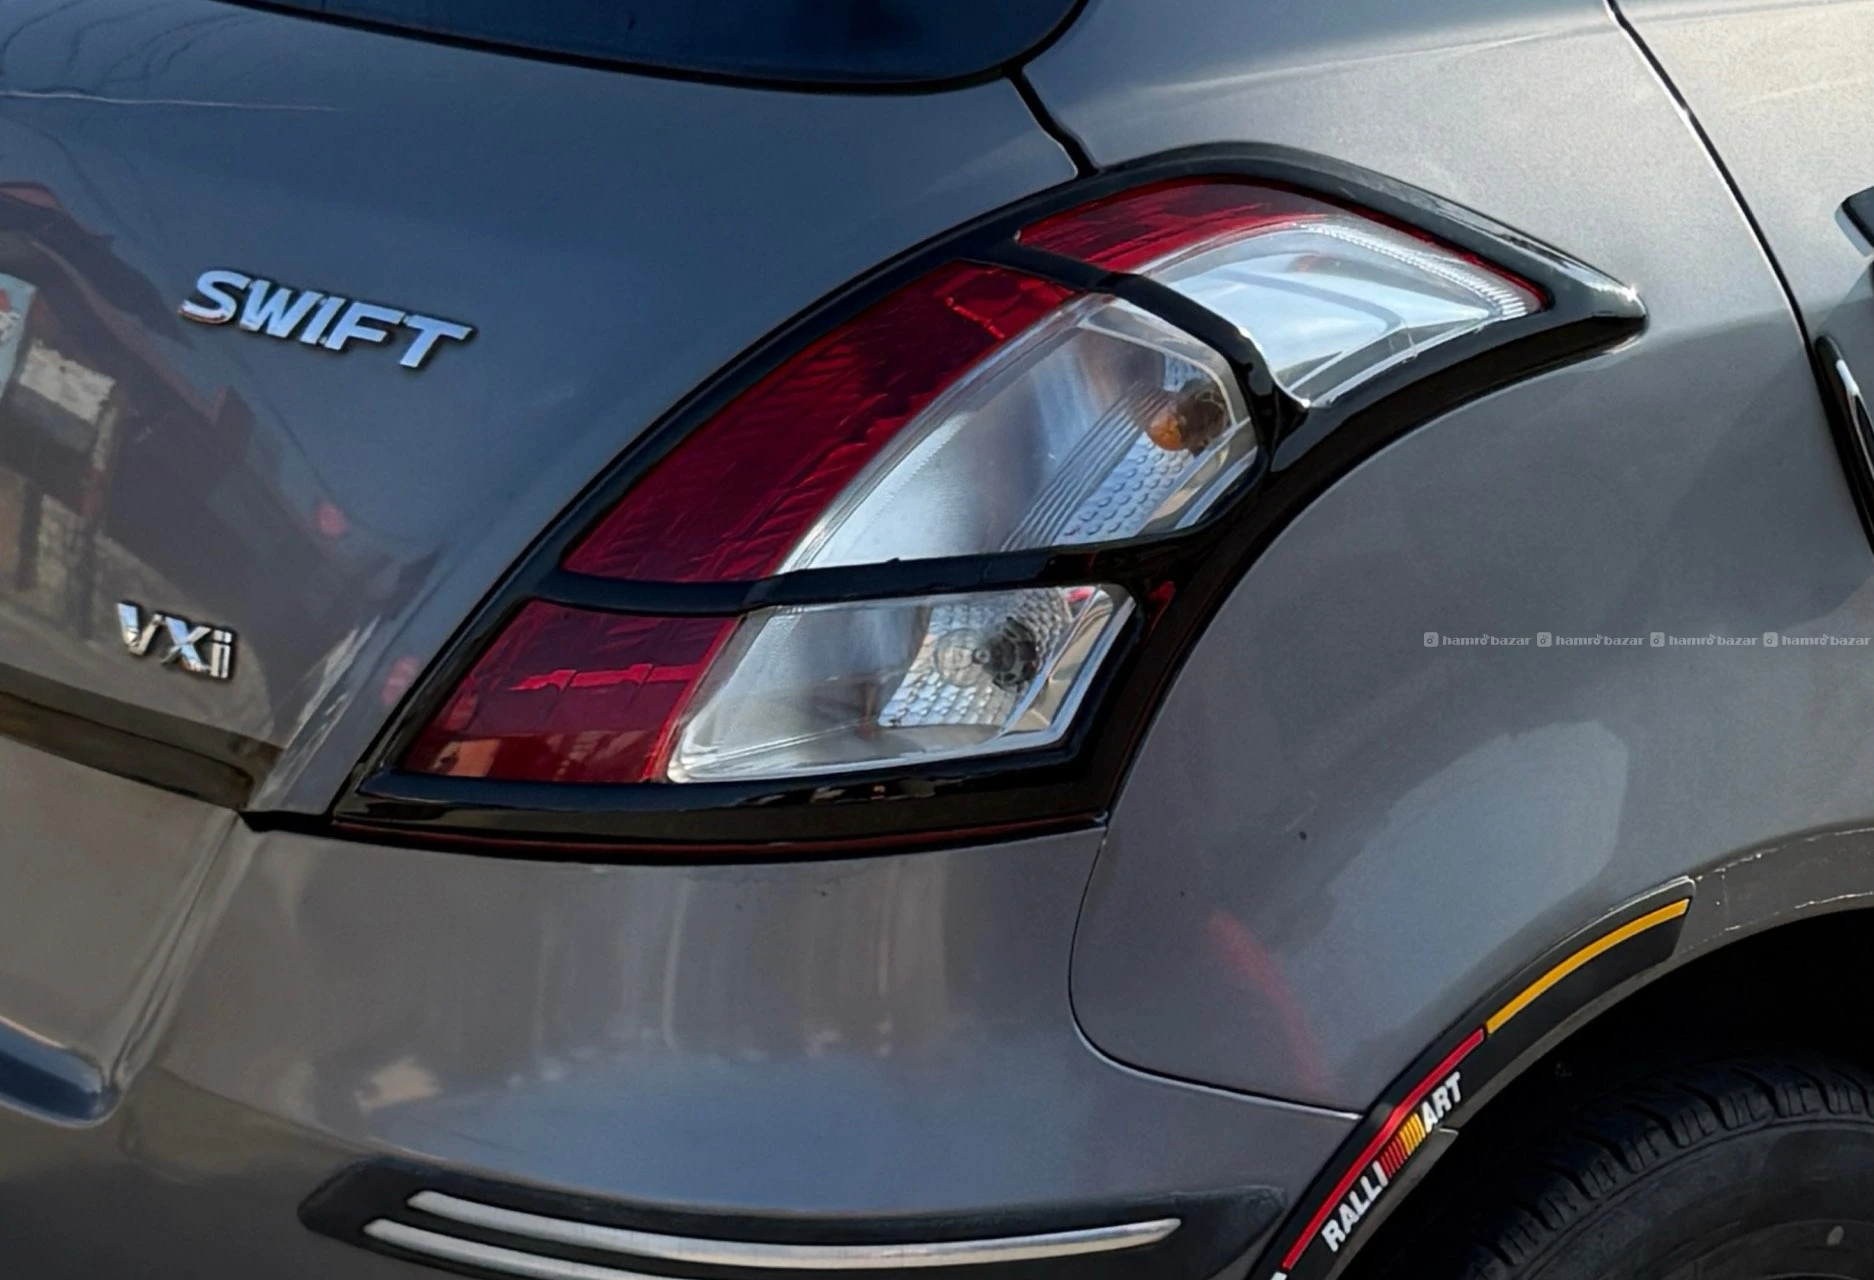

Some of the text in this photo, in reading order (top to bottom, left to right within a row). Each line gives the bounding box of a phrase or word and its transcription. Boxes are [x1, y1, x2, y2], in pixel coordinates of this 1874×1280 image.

[178, 269, 476, 369] SWIFT
[116, 600, 236, 681] VXi
[1320, 1070, 1462, 1252] RALLI ART
